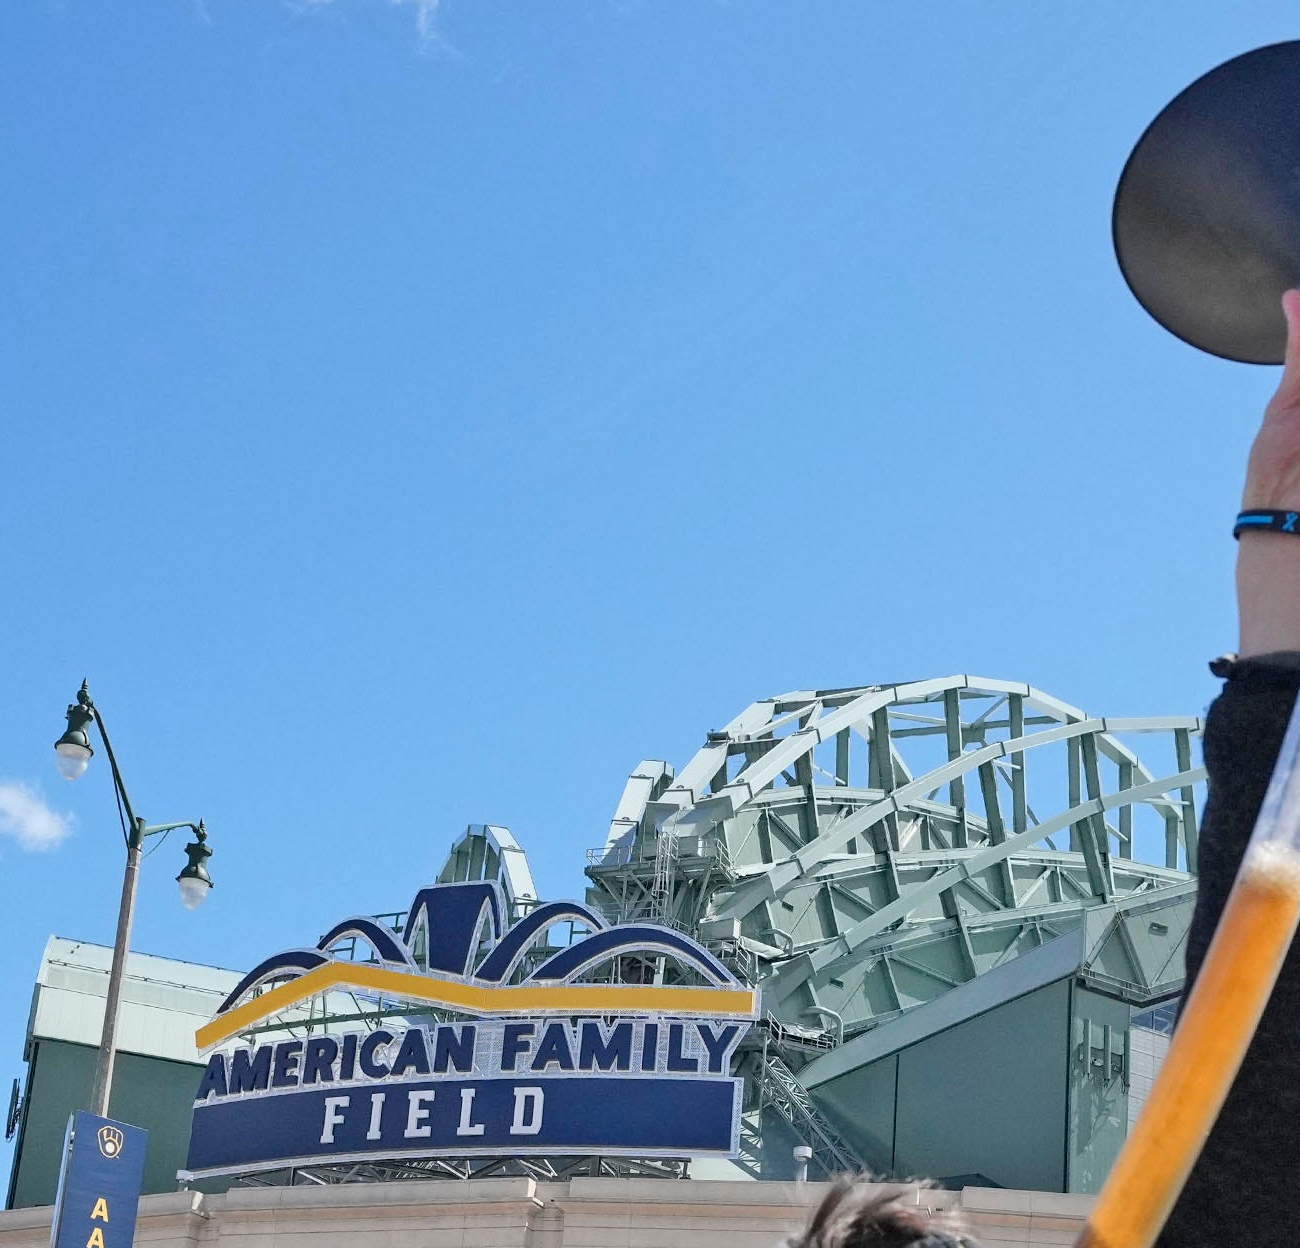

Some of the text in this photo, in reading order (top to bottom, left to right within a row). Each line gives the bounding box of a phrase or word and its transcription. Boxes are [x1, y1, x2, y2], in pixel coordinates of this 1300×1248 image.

[197, 1023, 740, 1099] AMERICAN FAMILY
[320, 1087, 545, 1144] FIELD
